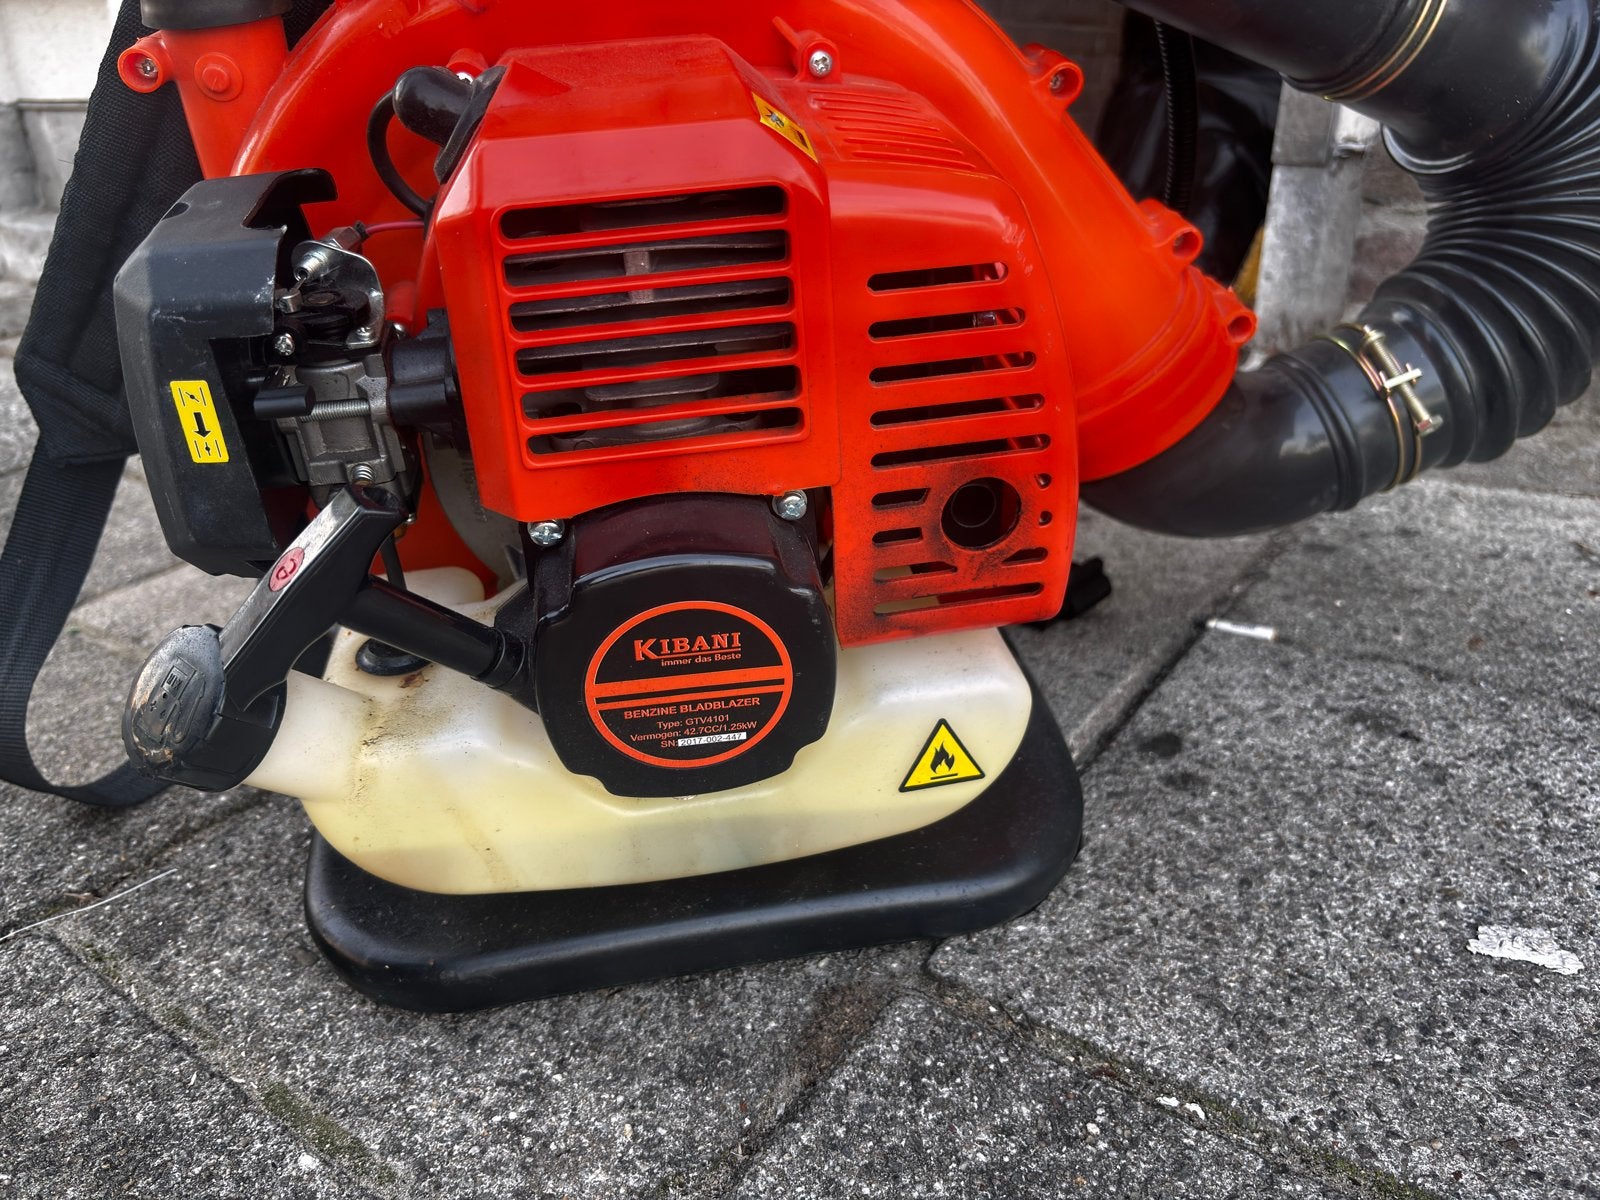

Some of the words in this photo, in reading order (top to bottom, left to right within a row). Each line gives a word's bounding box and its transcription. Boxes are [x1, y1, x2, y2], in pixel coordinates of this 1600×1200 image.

[634, 632, 742, 661] KIBANI
[661, 659, 692, 667] immer
[694, 655, 712, 663] das
[714, 652, 742, 661] Beste
[624, 706, 677, 720] BENZINE
[679, 697, 761, 713] BLADBLAZER
[656, 720, 683, 730] Type:
[685, 714, 730, 726] GTV4101
[630, 730, 682, 742] Vermogen:
[684, 721, 757, 736] 42.7CC/1.25kW
[660, 739, 679, 748] SN:
